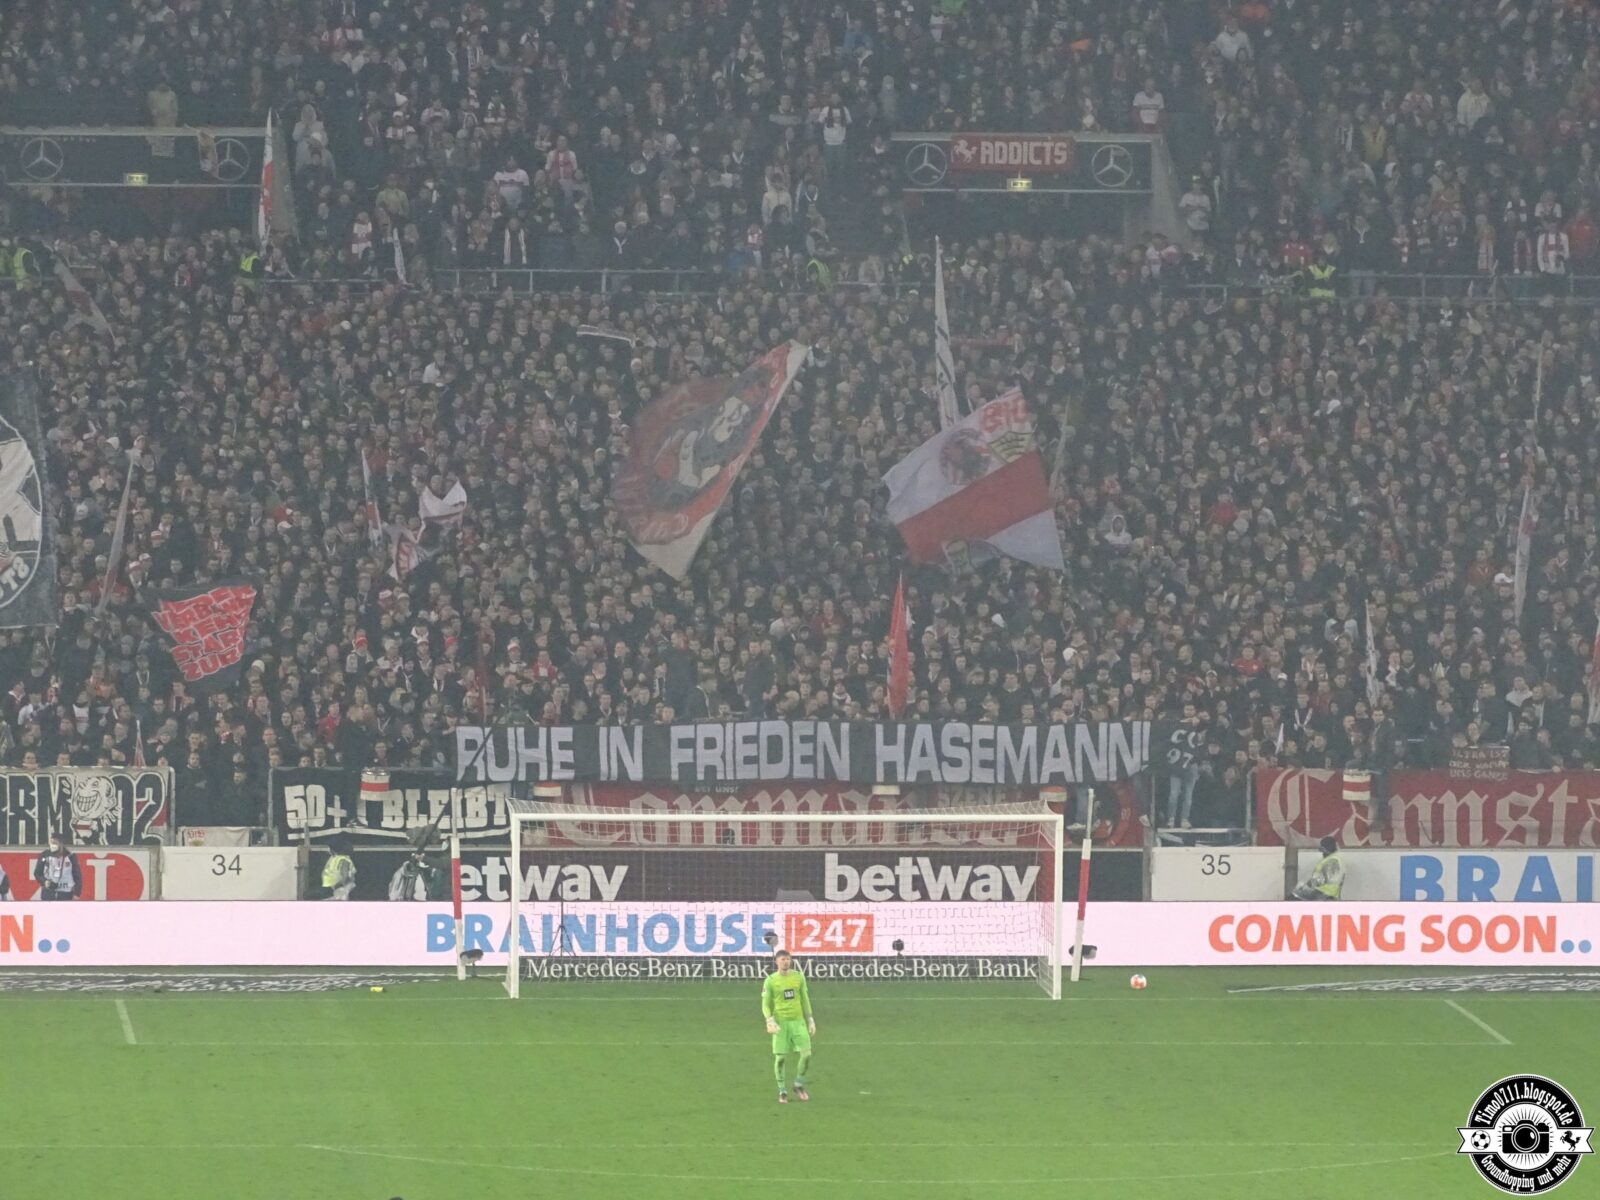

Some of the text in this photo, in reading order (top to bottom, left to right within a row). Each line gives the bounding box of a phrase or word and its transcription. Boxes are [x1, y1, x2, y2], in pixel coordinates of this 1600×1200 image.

[980, 141, 1068, 165] ADDICTS
[455, 720, 1151, 785] RUHE IN FRIEDEN HASEMANN!
[105, 772, 164, 845] 02
[380, 783, 511, 829] BLEIBT
[211, 854, 242, 876] 34
[824, 852, 1040, 902] betway
[1200, 853, 1232, 876] 35
[426, 913, 775, 953] BRAINHOUSE
[1208, 914, 1593, 954] COMING SOON..
[526, 957, 770, 979] Mercedes-Benz Bank
[791, 957, 1038, 979] Mercedes-Benz Bank
